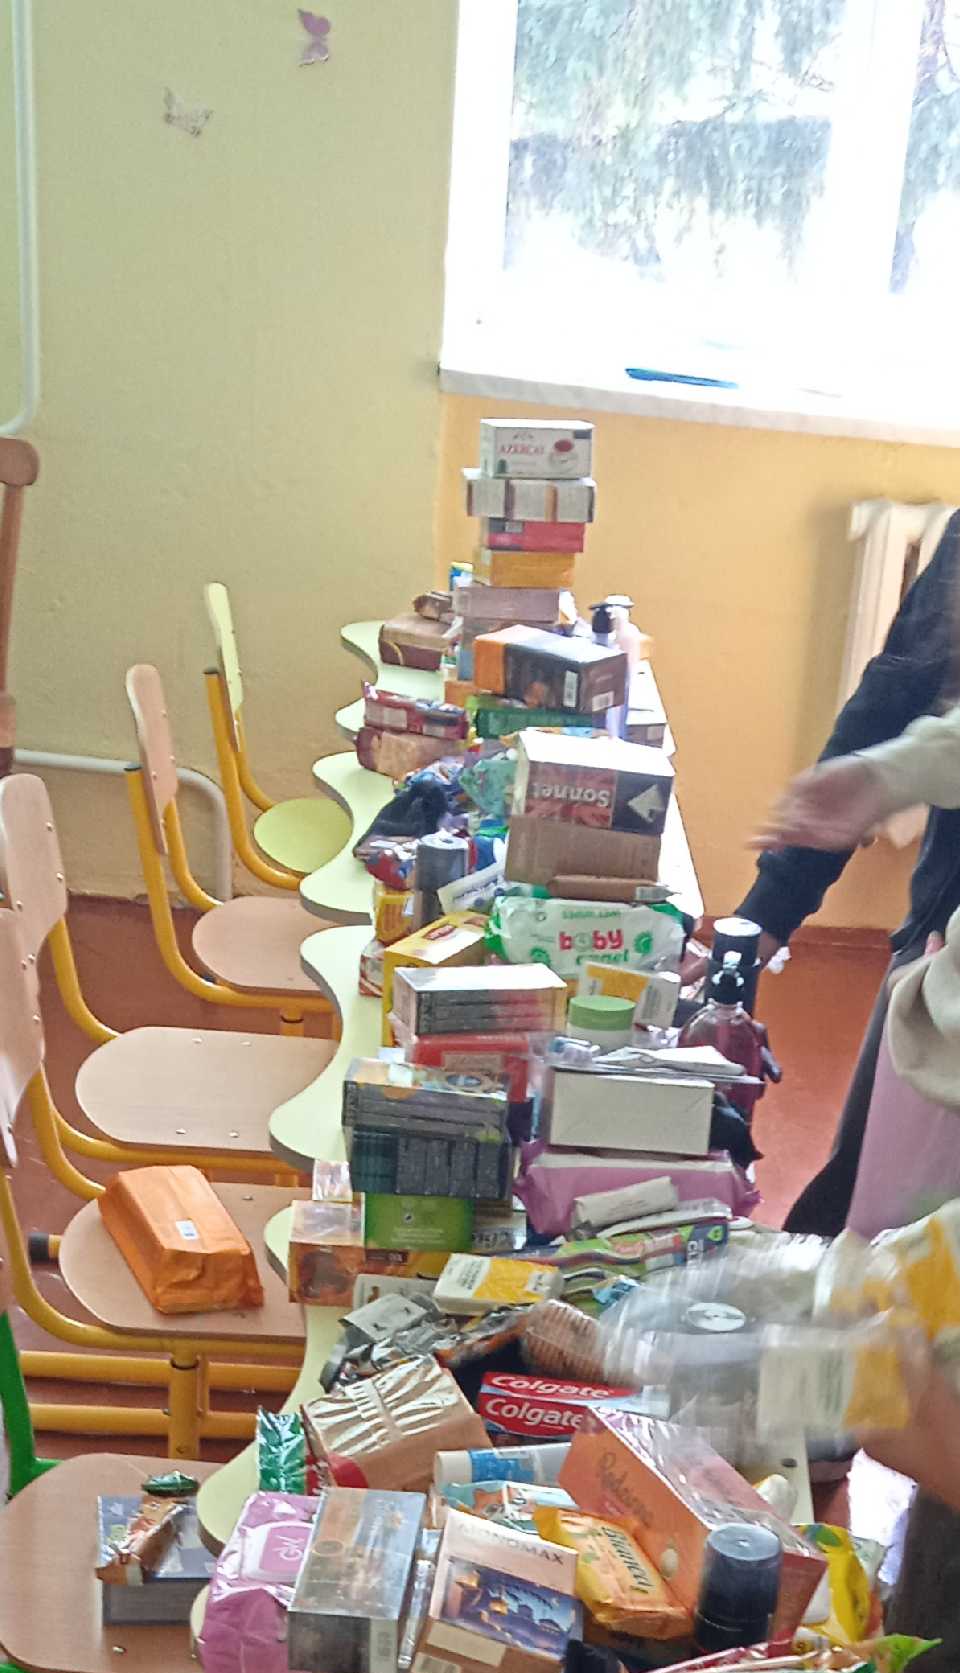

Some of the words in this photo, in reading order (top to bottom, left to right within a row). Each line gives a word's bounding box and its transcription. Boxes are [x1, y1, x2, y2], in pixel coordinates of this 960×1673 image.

[531, 782, 612, 808] Sonnet
[490, 1374, 613, 1399] Colgate
[484, 1396, 586, 1430] Colgate
